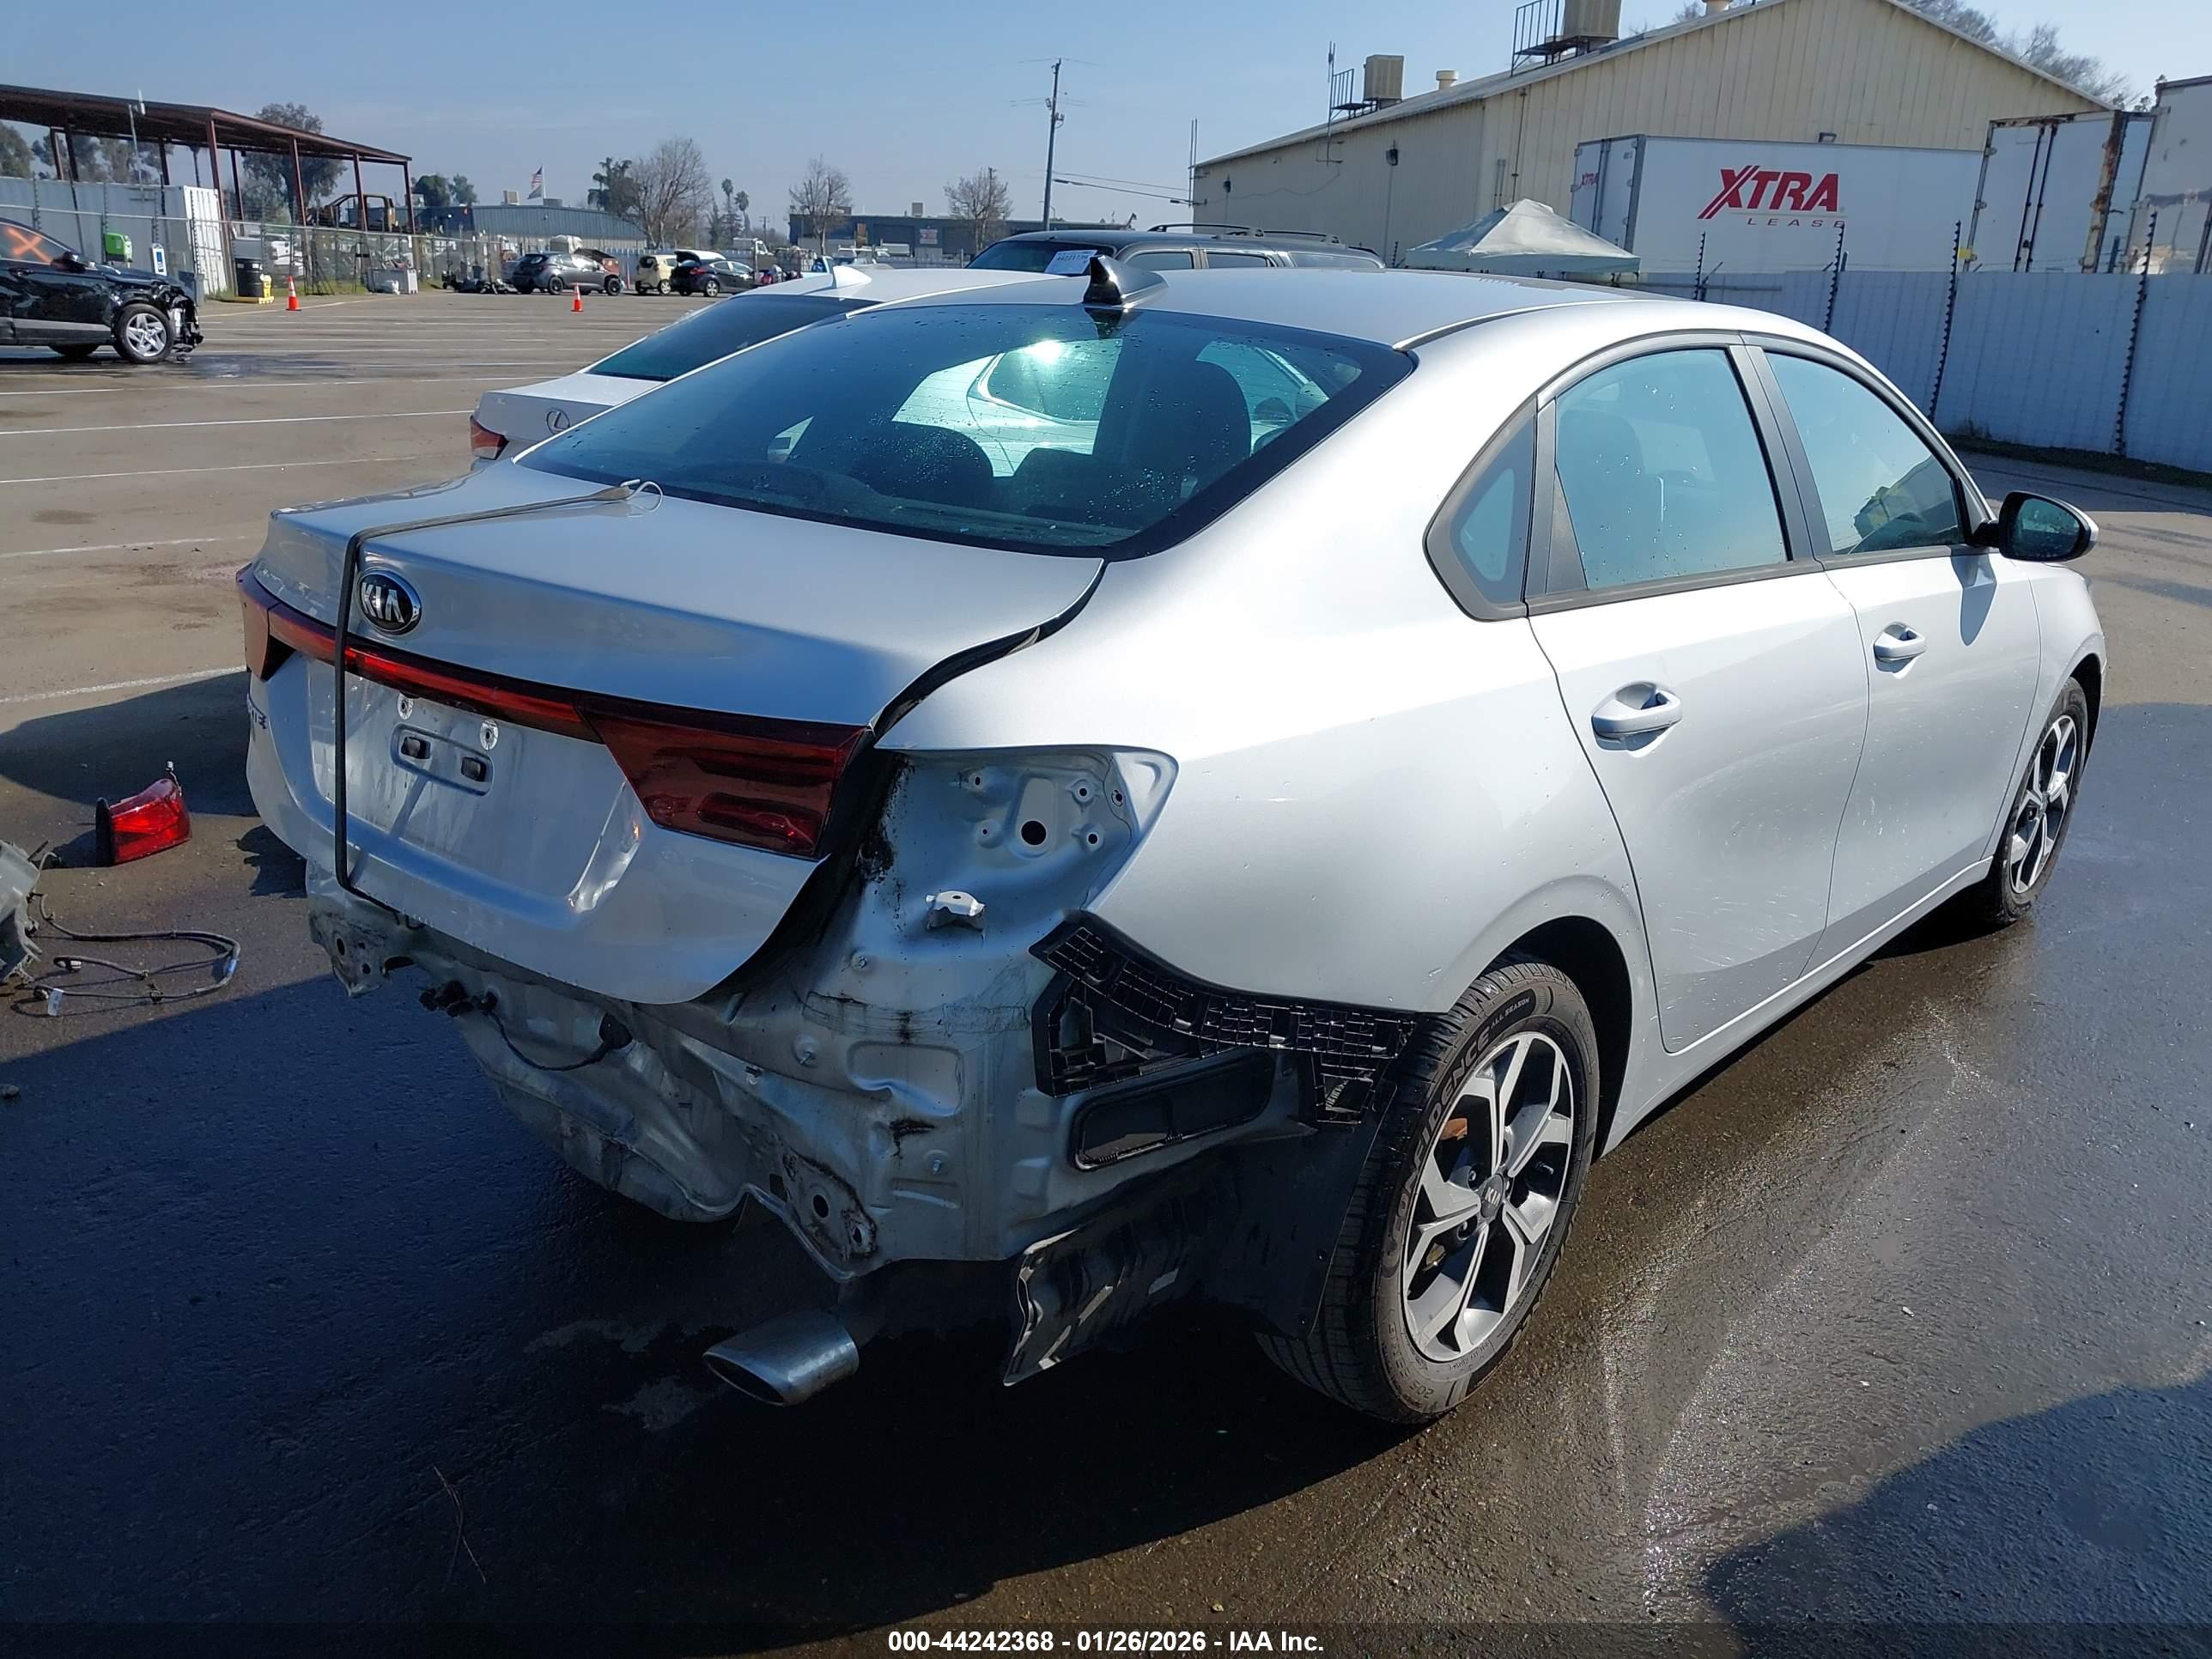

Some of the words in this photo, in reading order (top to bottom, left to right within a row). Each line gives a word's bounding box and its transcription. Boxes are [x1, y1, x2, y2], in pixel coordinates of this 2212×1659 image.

[1697, 164, 1840, 220] XTRA
[1747, 217, 1845, 228] LEASE
[362, 581, 404, 623] KIA
[1491, 1013, 1504, 1030] ALL
[1504, 996, 1531, 1017] SEASON
